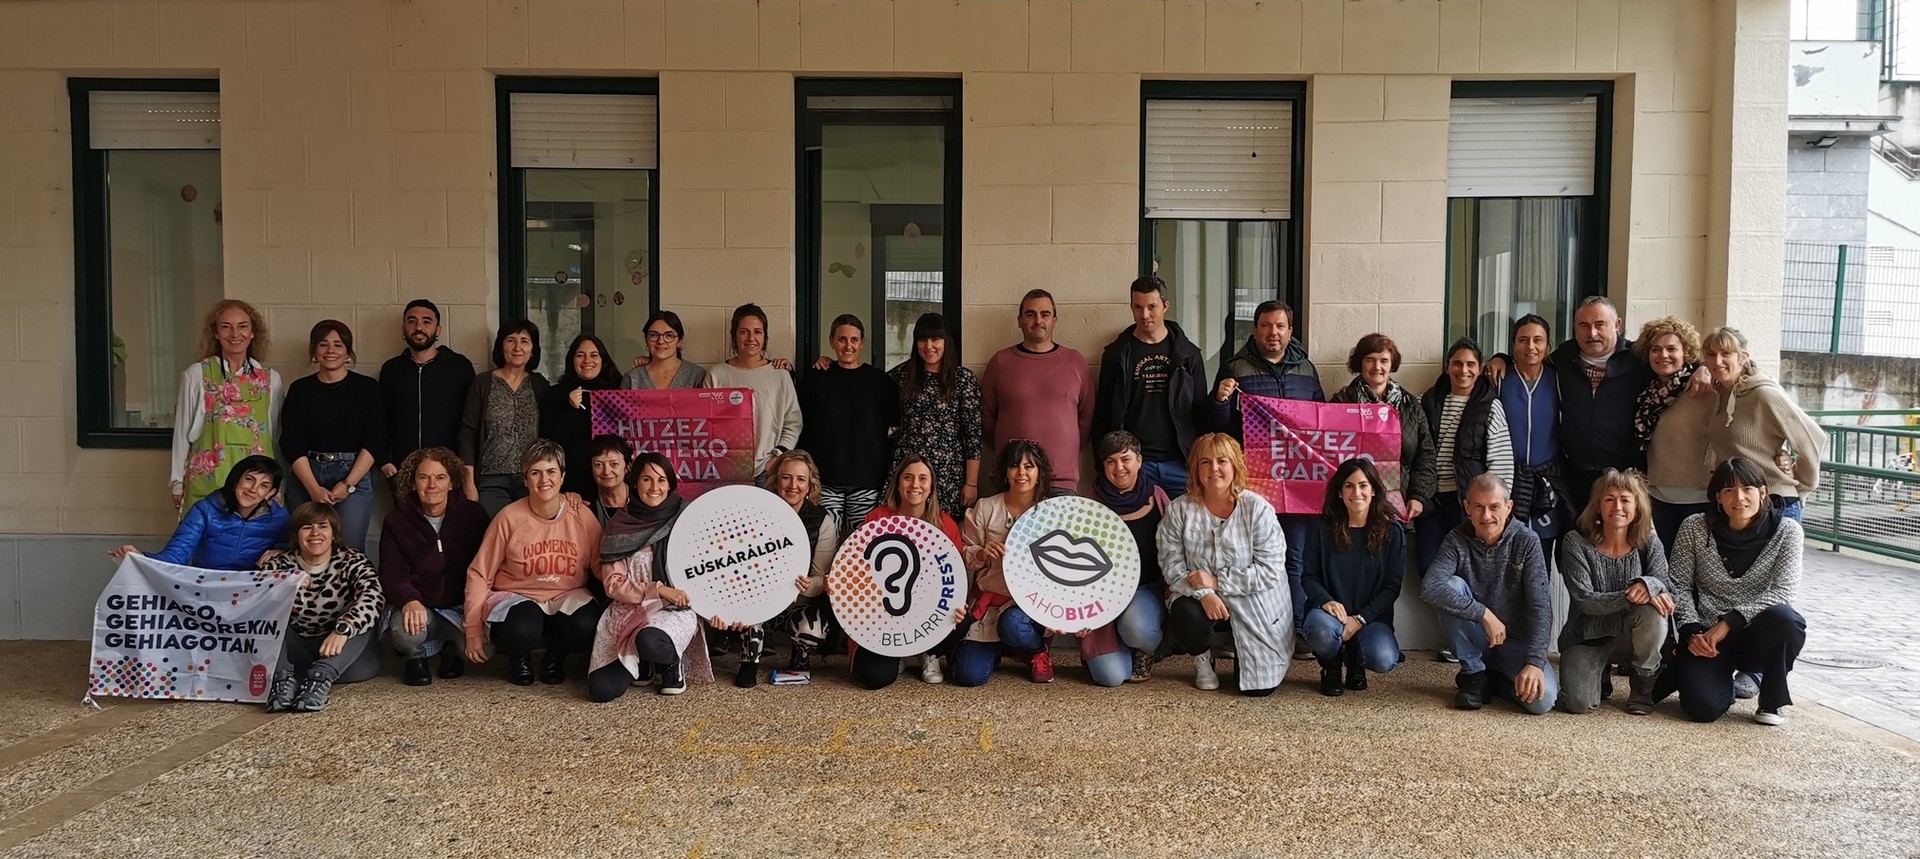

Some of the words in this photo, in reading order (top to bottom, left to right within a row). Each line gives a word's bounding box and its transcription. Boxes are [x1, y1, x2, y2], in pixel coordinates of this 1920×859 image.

[617, 418, 708, 438] HITZEZ
[626, 438, 728, 458] KITEKO
[523, 539, 578, 560] WOMEN'S
[522, 554, 578, 577] VOICE
[106, 594, 222, 624] GEHIAGO,
[1025, 592, 1104, 621] AHOBIZI
[106, 613, 281, 640] GEHIAGOREKIN,
[104, 633, 259, 655] GEHIAGOTAN.
